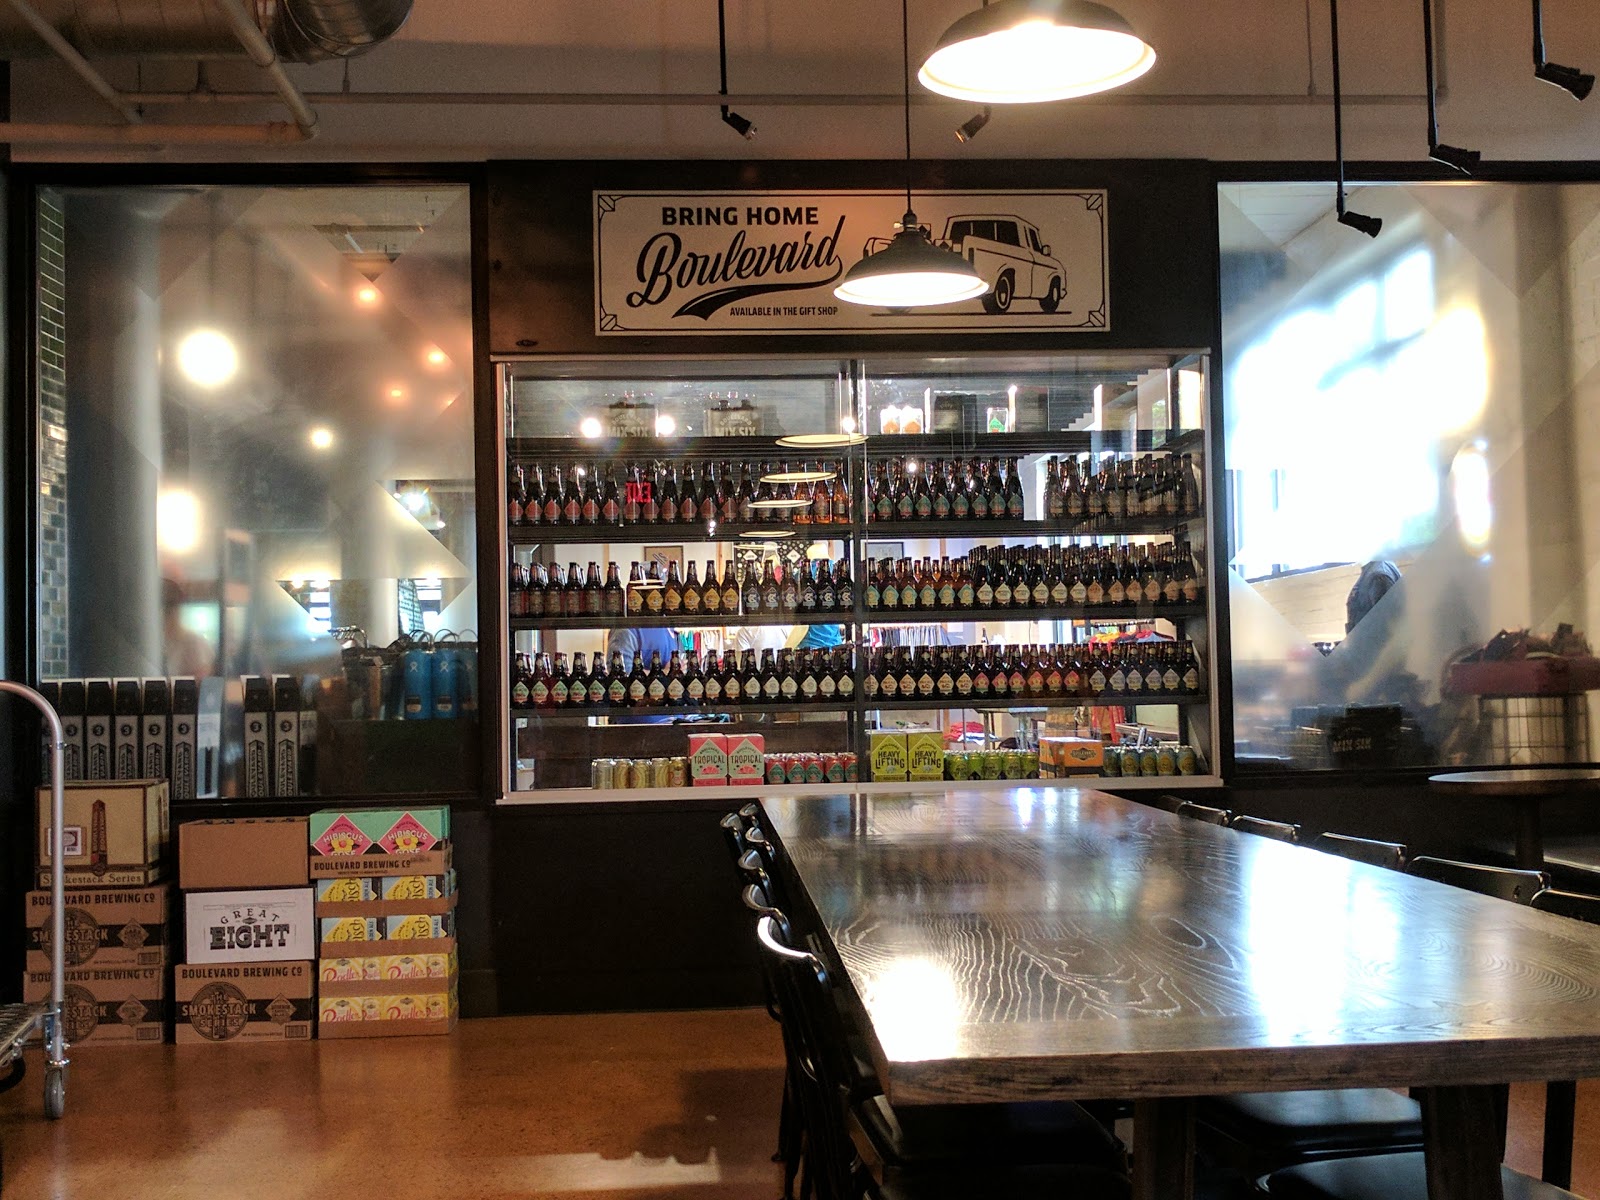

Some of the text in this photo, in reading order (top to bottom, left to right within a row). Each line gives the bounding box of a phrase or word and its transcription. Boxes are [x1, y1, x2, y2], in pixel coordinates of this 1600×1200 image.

[662, 206, 819, 226] BRING HOME
[626, 214, 846, 308] Boulevard
[730, 306, 839, 317] AVAILABLE IN THE GIFT SHOP
[715, 426, 756, 436] MIX SIX
[694, 755, 725, 764] TROPICAL
[730, 755, 762, 764] TROPICAL
[878, 750, 901, 759] HEAVY
[914, 750, 938, 758] HEAVY
[875, 757, 905, 769] LIFTING
[912, 757, 942, 769] LIFTING
[323, 831, 364, 843] HIBISCUS
[388, 829, 429, 841] HIBISCUS
[314, 860, 360, 871] BOULEVARD
[363, 860, 399, 869] BREWING
[43, 872, 142, 884] Skestack Series
[32, 894, 91, 906] BOUVARD
[94, 893, 141, 904] BREWING
[220, 908, 280, 924] GREAT
[32, 929, 108, 942] SMESTACK
[210, 923, 290, 950] EIGHT
[30, 972, 91, 983] BOUVARD
[93, 970, 140, 981] BREWING
[182, 967, 240, 979] BOULEVARD
[243, 967, 289, 977] BREWING
[65, 1006, 107, 1017] ESTACK
[182, 1003, 257, 1016] SMOKESTACK
[200, 1019, 240, 1028] SERIES
